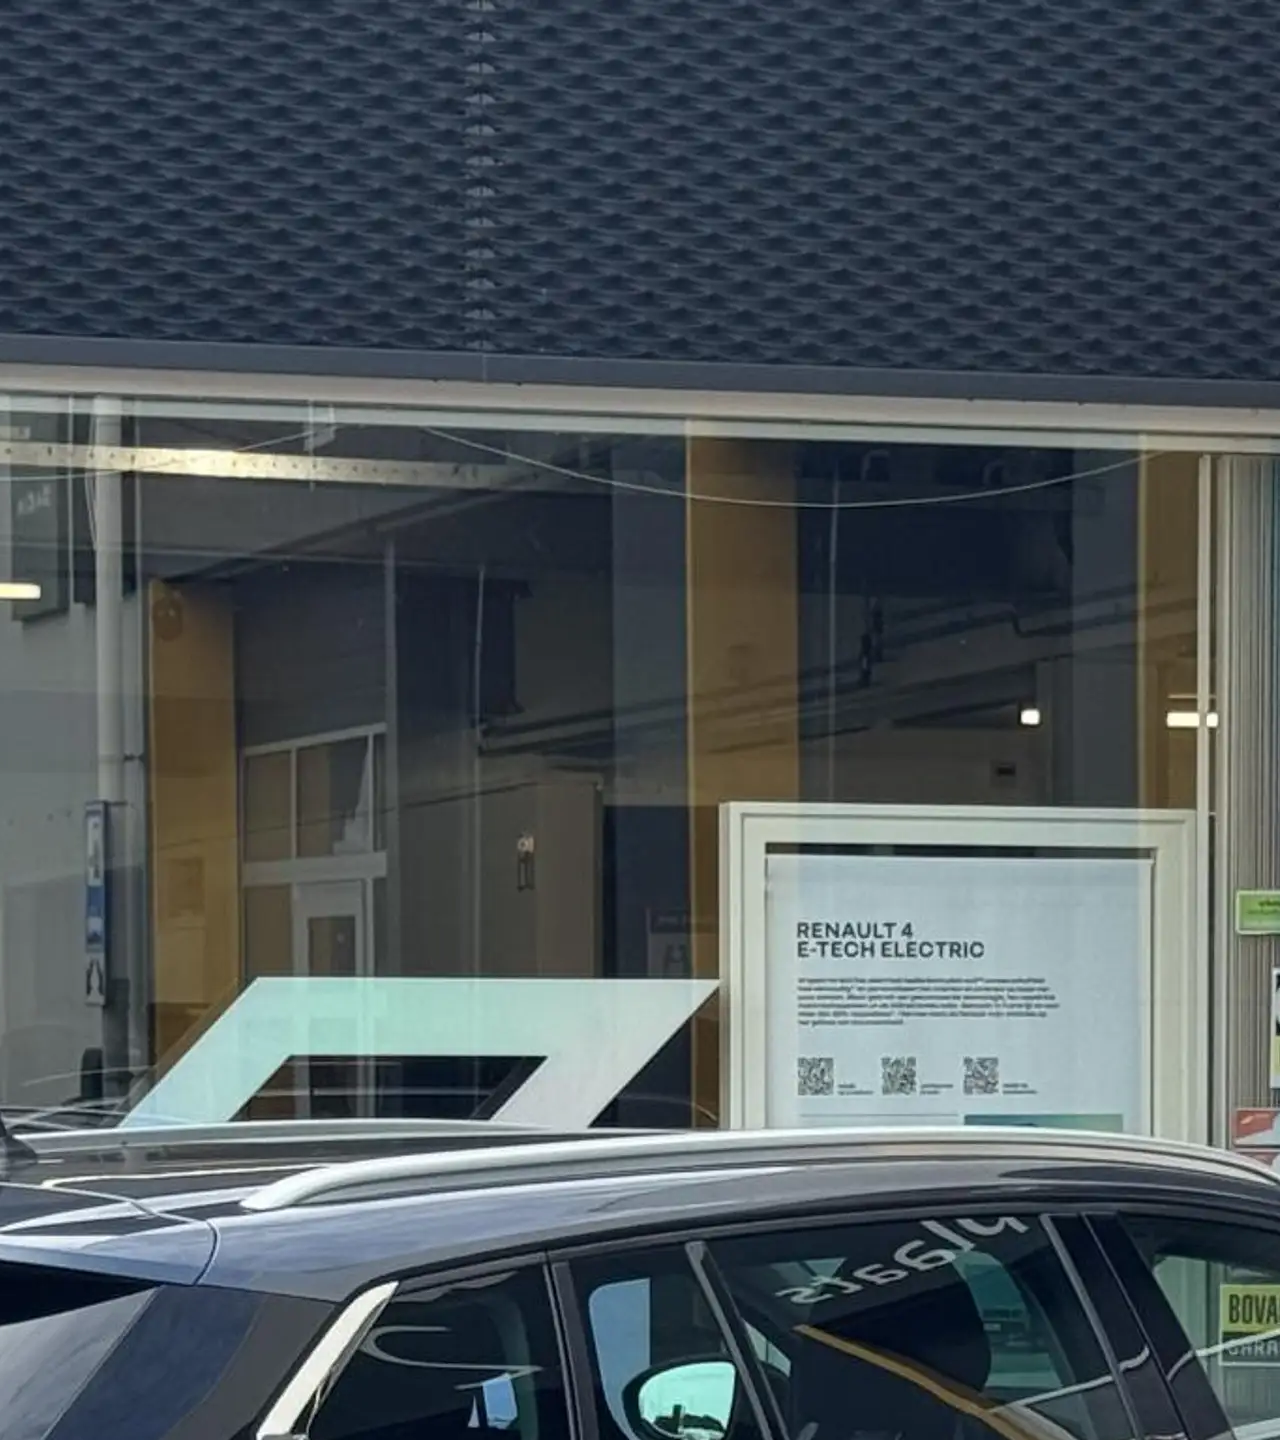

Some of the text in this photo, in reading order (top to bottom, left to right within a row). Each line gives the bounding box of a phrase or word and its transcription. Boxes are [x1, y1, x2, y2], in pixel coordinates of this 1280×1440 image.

[797, 922, 913, 939] RENAULT 4
[797, 941, 986, 958] E-TECH ELECTRIC
